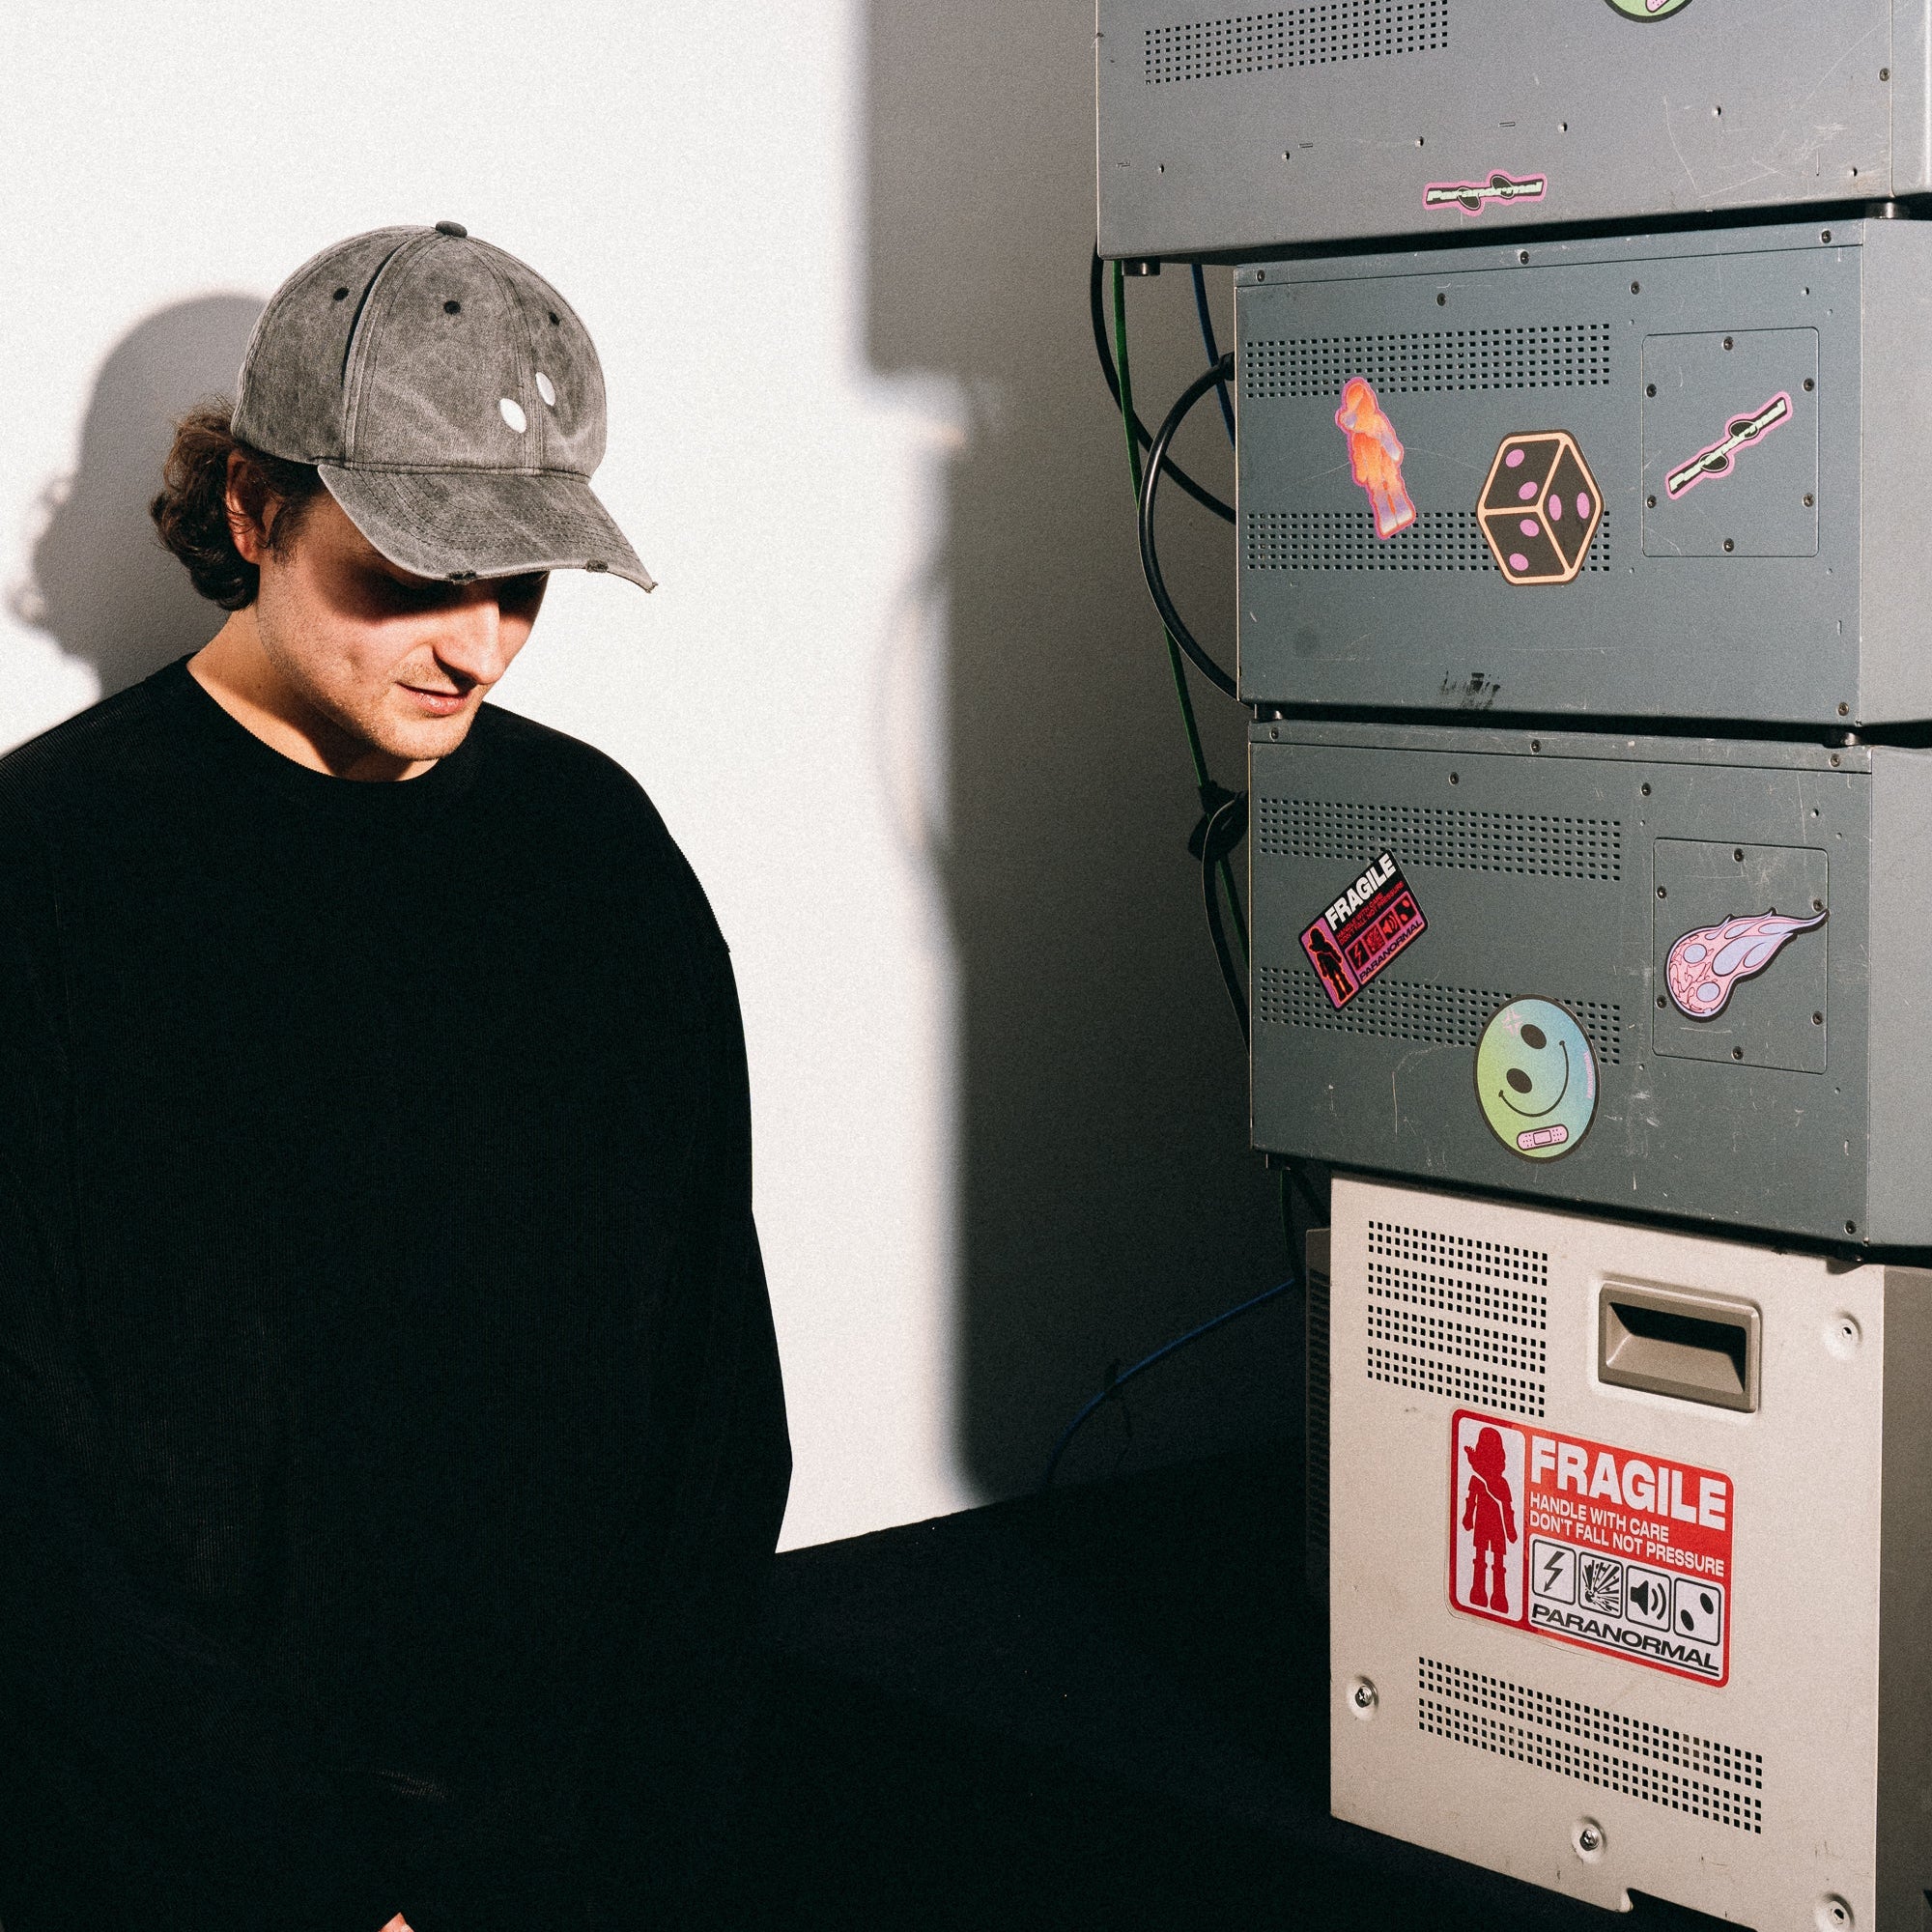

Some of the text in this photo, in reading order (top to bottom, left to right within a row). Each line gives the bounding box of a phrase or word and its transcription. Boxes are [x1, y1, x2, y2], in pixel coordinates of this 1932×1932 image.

[1324, 853, 1397, 931] FRAGILE
[1359, 920, 1423, 981] PARANORMAL
[1531, 1435, 1726, 1531] FRAGILE
[1529, 1509, 1724, 1577] DON'T FALL NOT PRESSURE
[1530, 1492, 1669, 1544] HANDLE WITH CARE
[1531, 1604, 1719, 1671] PARANORMAL
